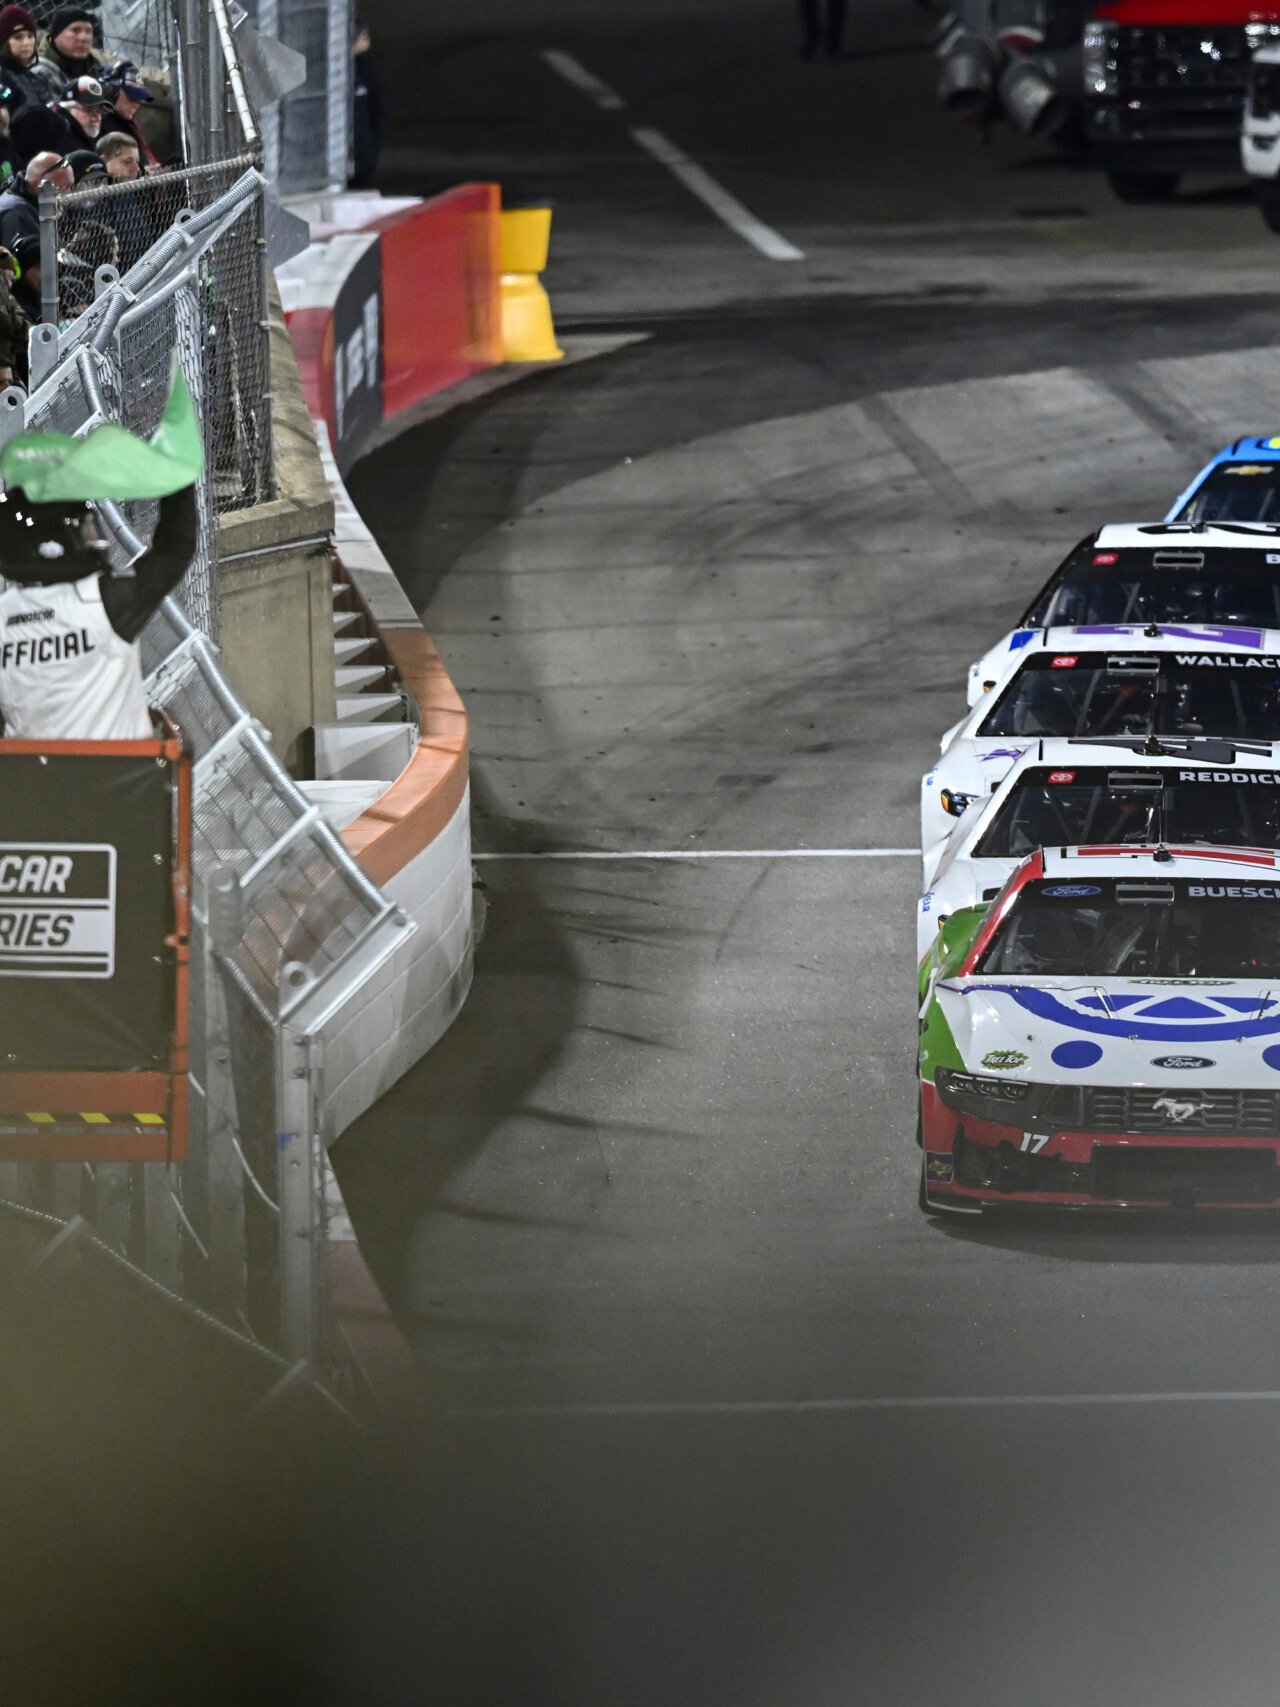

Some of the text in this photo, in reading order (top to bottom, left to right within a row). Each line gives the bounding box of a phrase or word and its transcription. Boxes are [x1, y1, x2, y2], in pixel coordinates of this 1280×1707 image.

[0, 628, 95, 669] FFICIAL
[1162, 1056, 1203, 1068] Ford
[1020, 1131, 1050, 1154] 17
